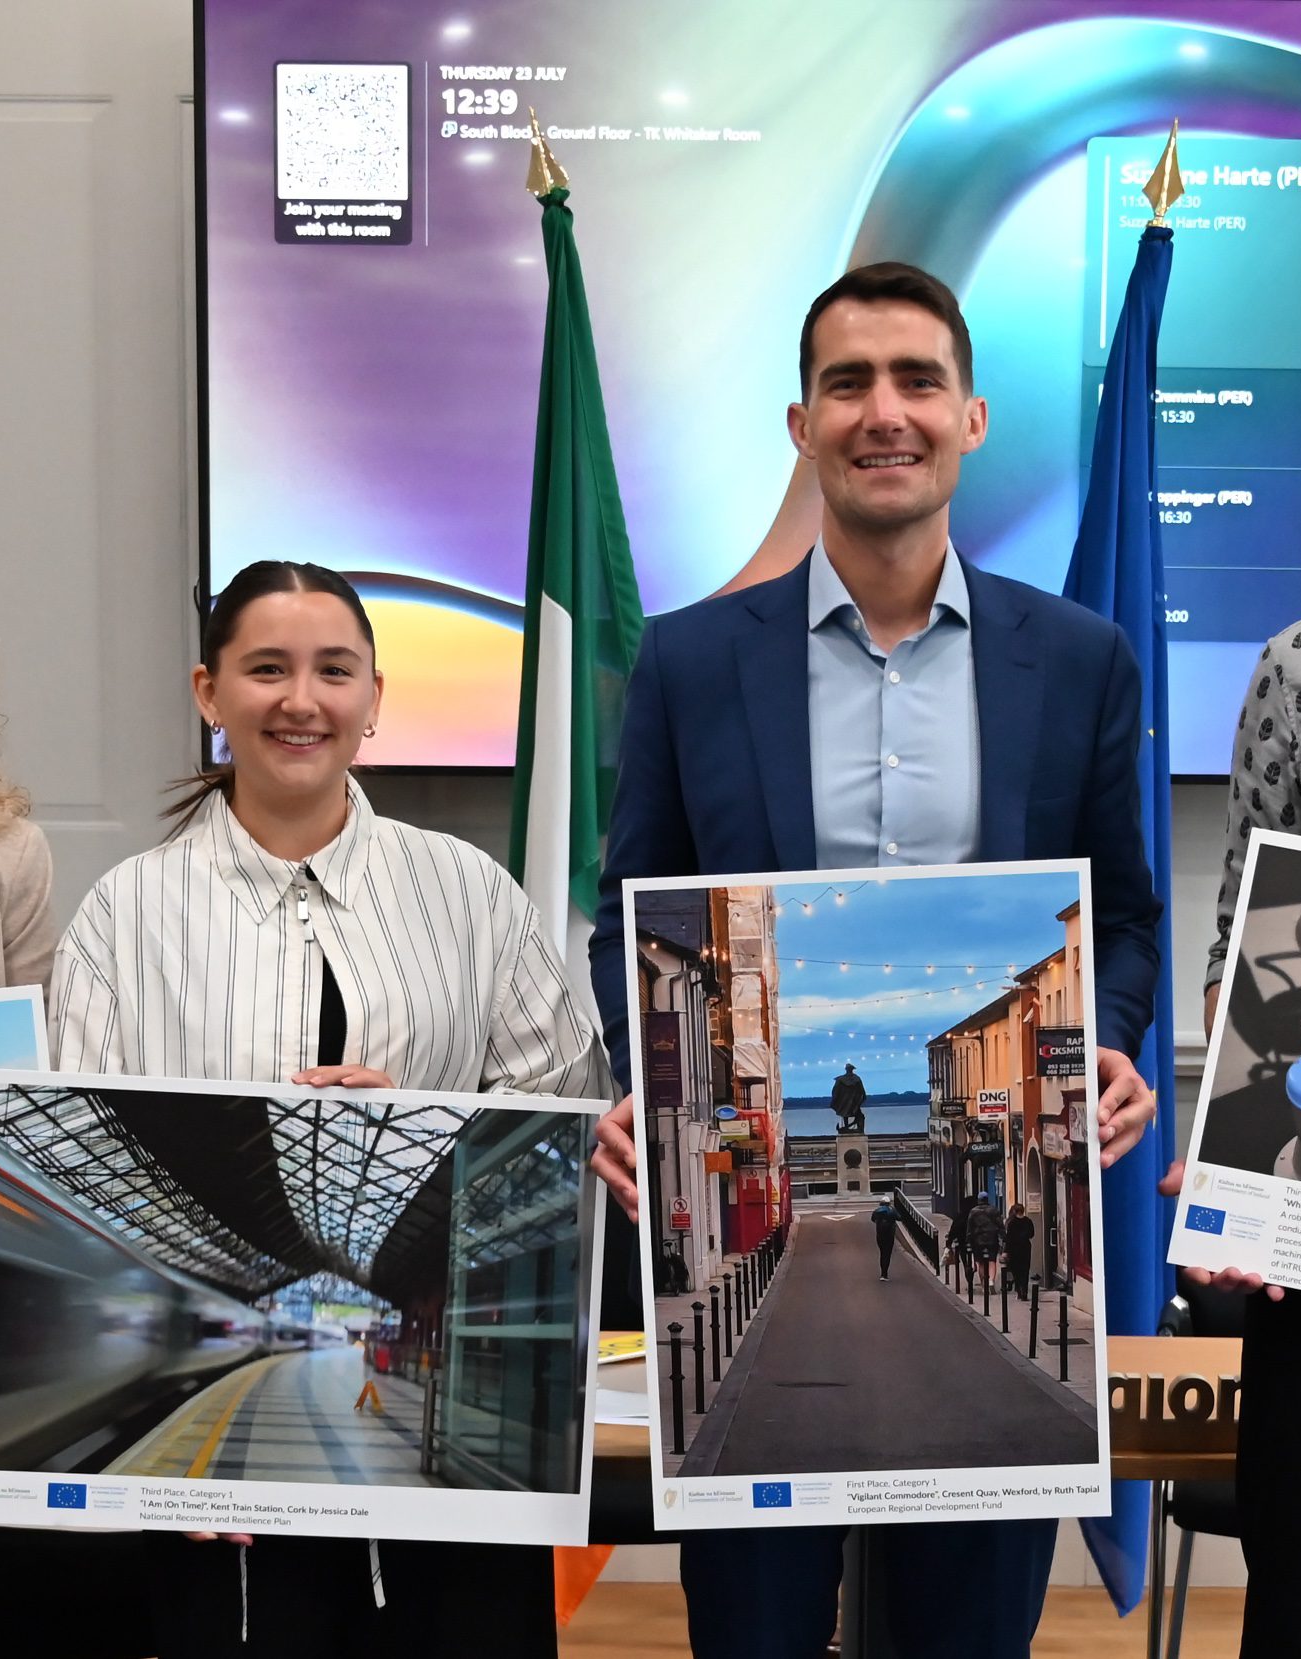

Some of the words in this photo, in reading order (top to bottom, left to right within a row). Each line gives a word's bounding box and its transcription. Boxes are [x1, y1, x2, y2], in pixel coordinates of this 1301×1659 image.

[440, 65, 512, 81] THURSDAY
[515, 66, 533, 81] 23
[534, 67, 567, 81] JULY
[441, 88, 518, 115] 12:39
[460, 124, 498, 139] South
[547, 126, 596, 140] Ground
[598, 126, 632, 140] Floor
[722, 128, 761, 142] Room
[1213, 165, 1272, 187] Harte
[283, 201, 312, 216] Join
[313, 205, 345, 219] your
[347, 202, 402, 220] meeting
[295, 221, 326, 236] with
[327, 222, 353, 236] this
[354, 225, 391, 237] room
[1175, 216, 1210, 229] Harte
[1213, 216, 1246, 231] (PER)
[1218, 390, 1253, 406] (PER)
[1161, 410, 1195, 423] 15:30
[1217, 491, 1253, 506] (PER)
[1158, 511, 1192, 524] 16:30
[979, 1091, 1007, 1103] DNG
[846, 1480, 864, 1488] First
[892, 1479, 929, 1487] Category
[932, 1478, 936, 1486] 1
[141, 1487, 161, 1496] Third
[163, 1488, 186, 1498] Place,
[189, 1489, 226, 1499] Category
[976, 1489, 1000, 1497] Quay,
[1002, 1487, 1040, 1496] Wexford,
[1042, 1487, 1052, 1495] by
[1054, 1486, 1074, 1494] Ruth
[1076, 1485, 1099, 1494] Tapial
[148, 1500, 162, 1508] Am
[164, 1500, 179, 1509] (On
[232, 1503, 252, 1511] Train
[254, 1504, 284, 1513] Station,
[308, 1506, 319, 1515] by
[320, 1507, 348, 1515] Jessica
[350, 1508, 368, 1516] Dale
[848, 1506, 886, 1514] European
[888, 1504, 922, 1513] Regional
[925, 1502, 979, 1511] Development
[982, 1501, 1002, 1509] Fund
[139, 1512, 173, 1520] National
[176, 1513, 213, 1523] Recovery
[214, 1515, 229, 1523] and
[232, 1515, 271, 1525] Resilience
[274, 1517, 291, 1525] Plan
